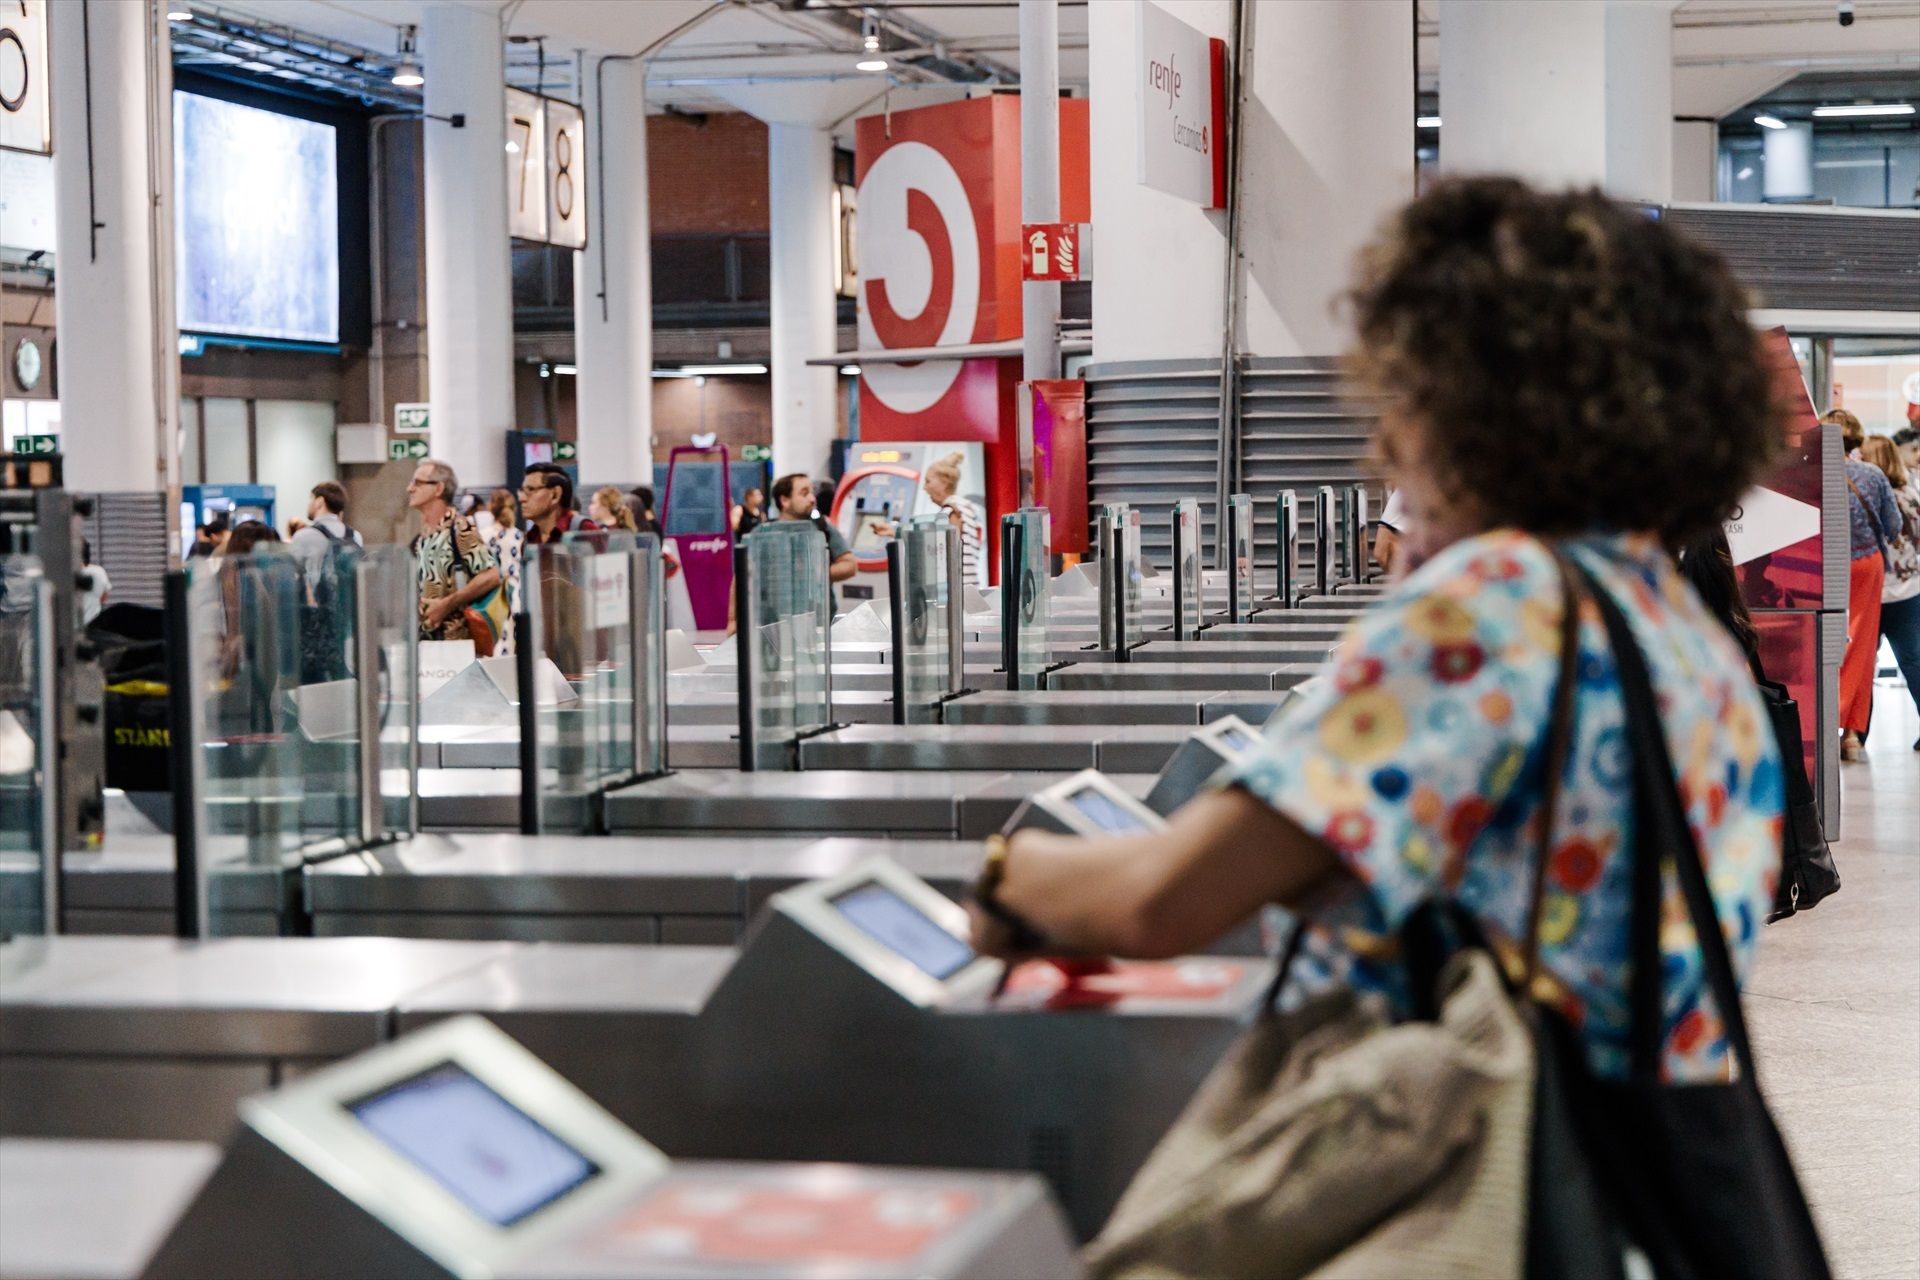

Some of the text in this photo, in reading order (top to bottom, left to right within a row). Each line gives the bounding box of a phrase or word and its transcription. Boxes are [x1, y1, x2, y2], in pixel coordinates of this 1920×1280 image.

[1149, 53, 1181, 110] renfe
[514, 118, 574, 221] 7 8
[689, 536, 728, 554] renfe
